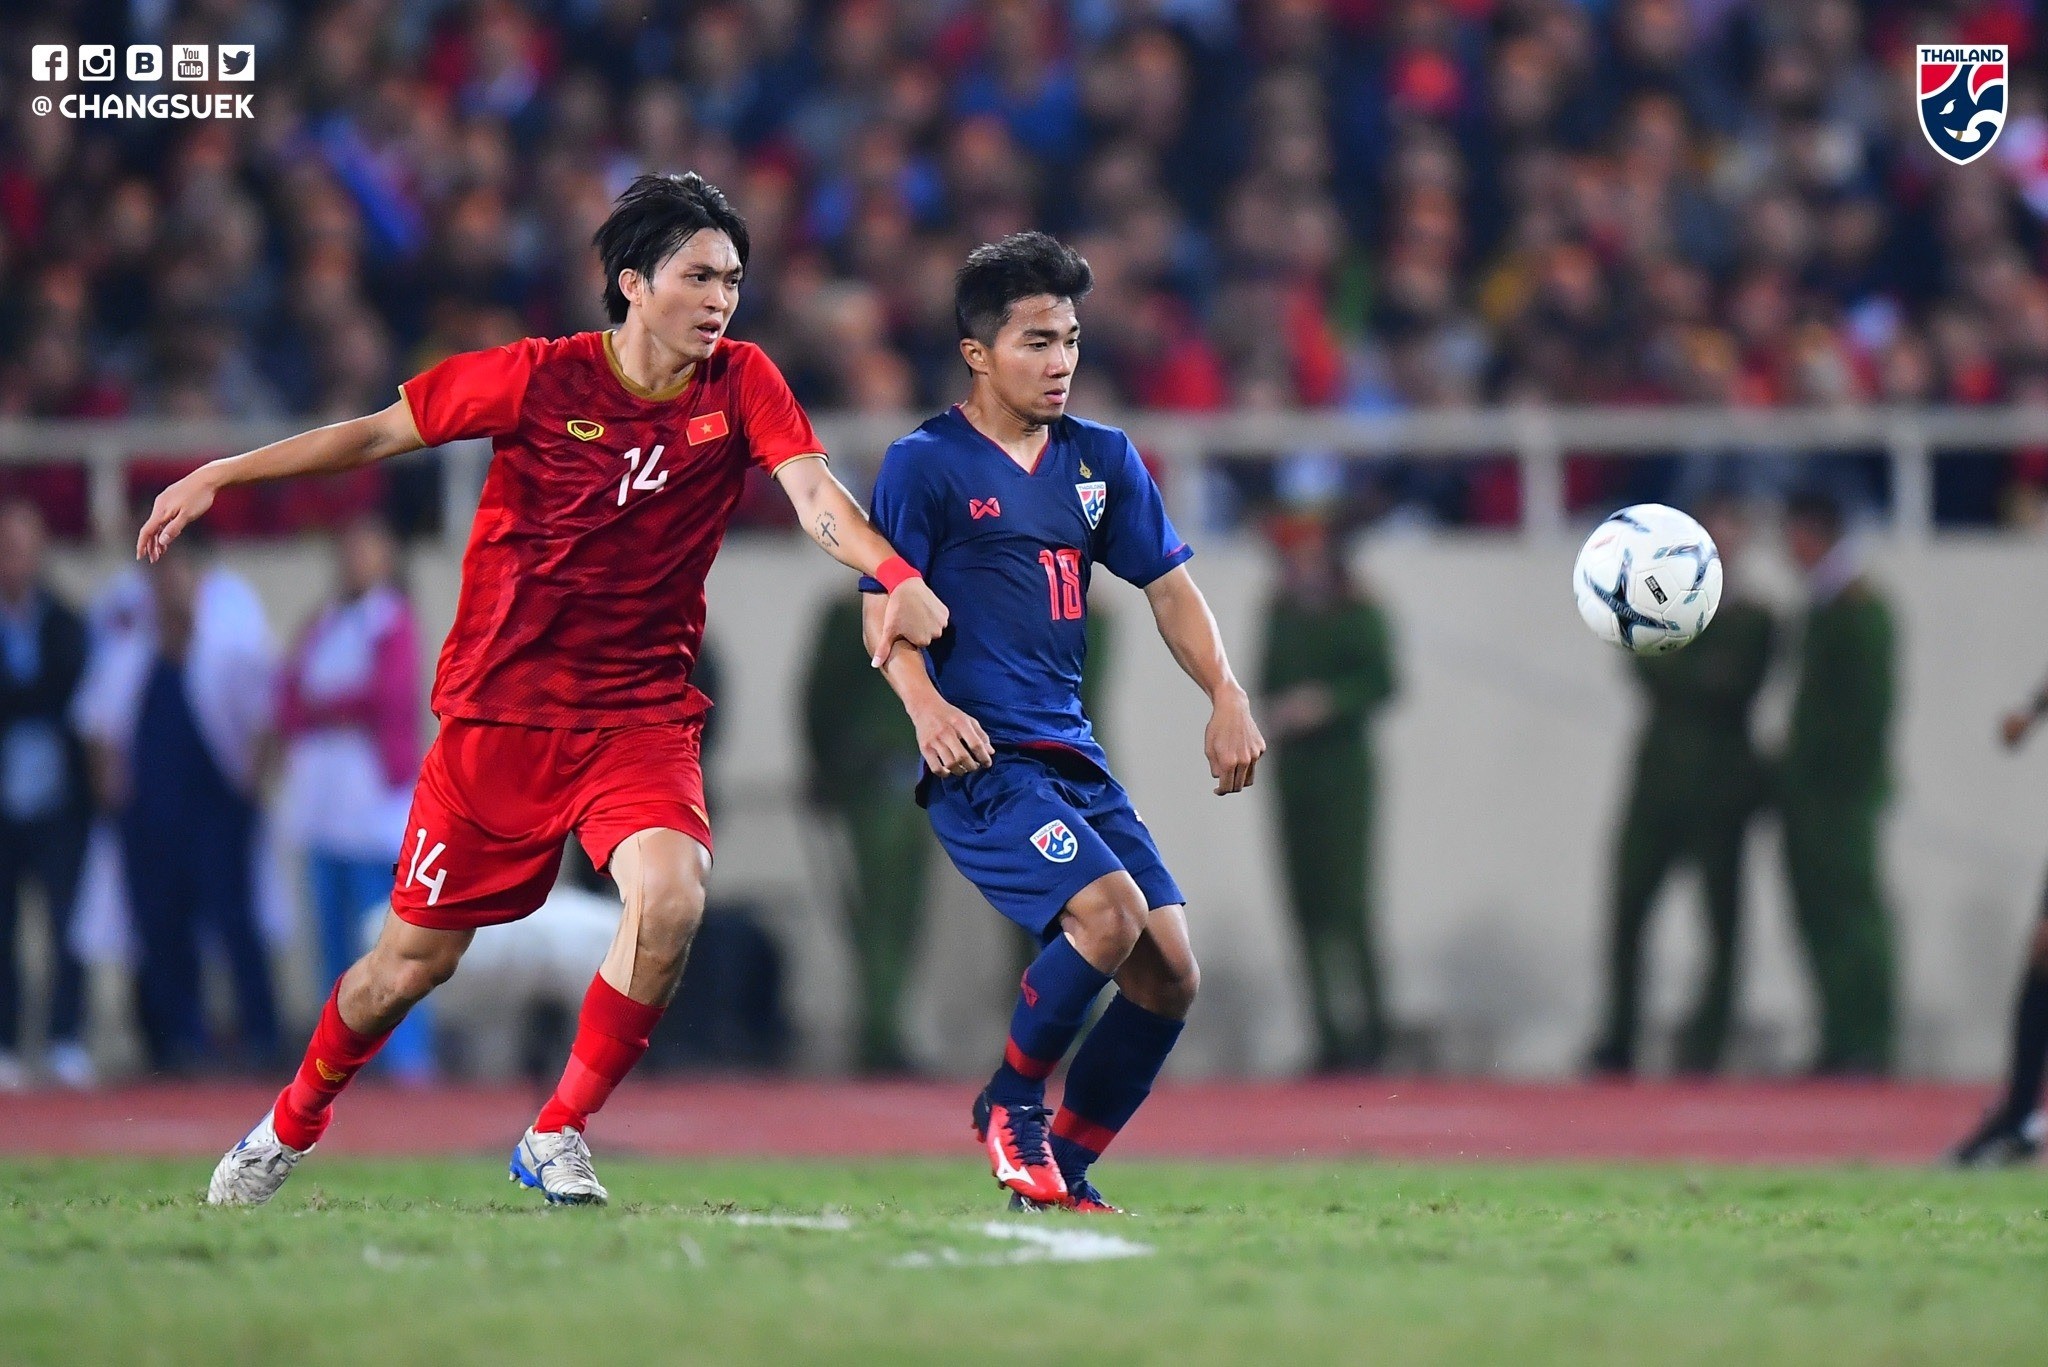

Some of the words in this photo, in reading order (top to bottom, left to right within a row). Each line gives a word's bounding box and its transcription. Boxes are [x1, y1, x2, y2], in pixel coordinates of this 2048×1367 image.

[617, 445, 669, 507] 14
[1038, 548, 1082, 621] 18
[405, 828, 448, 906] 14
